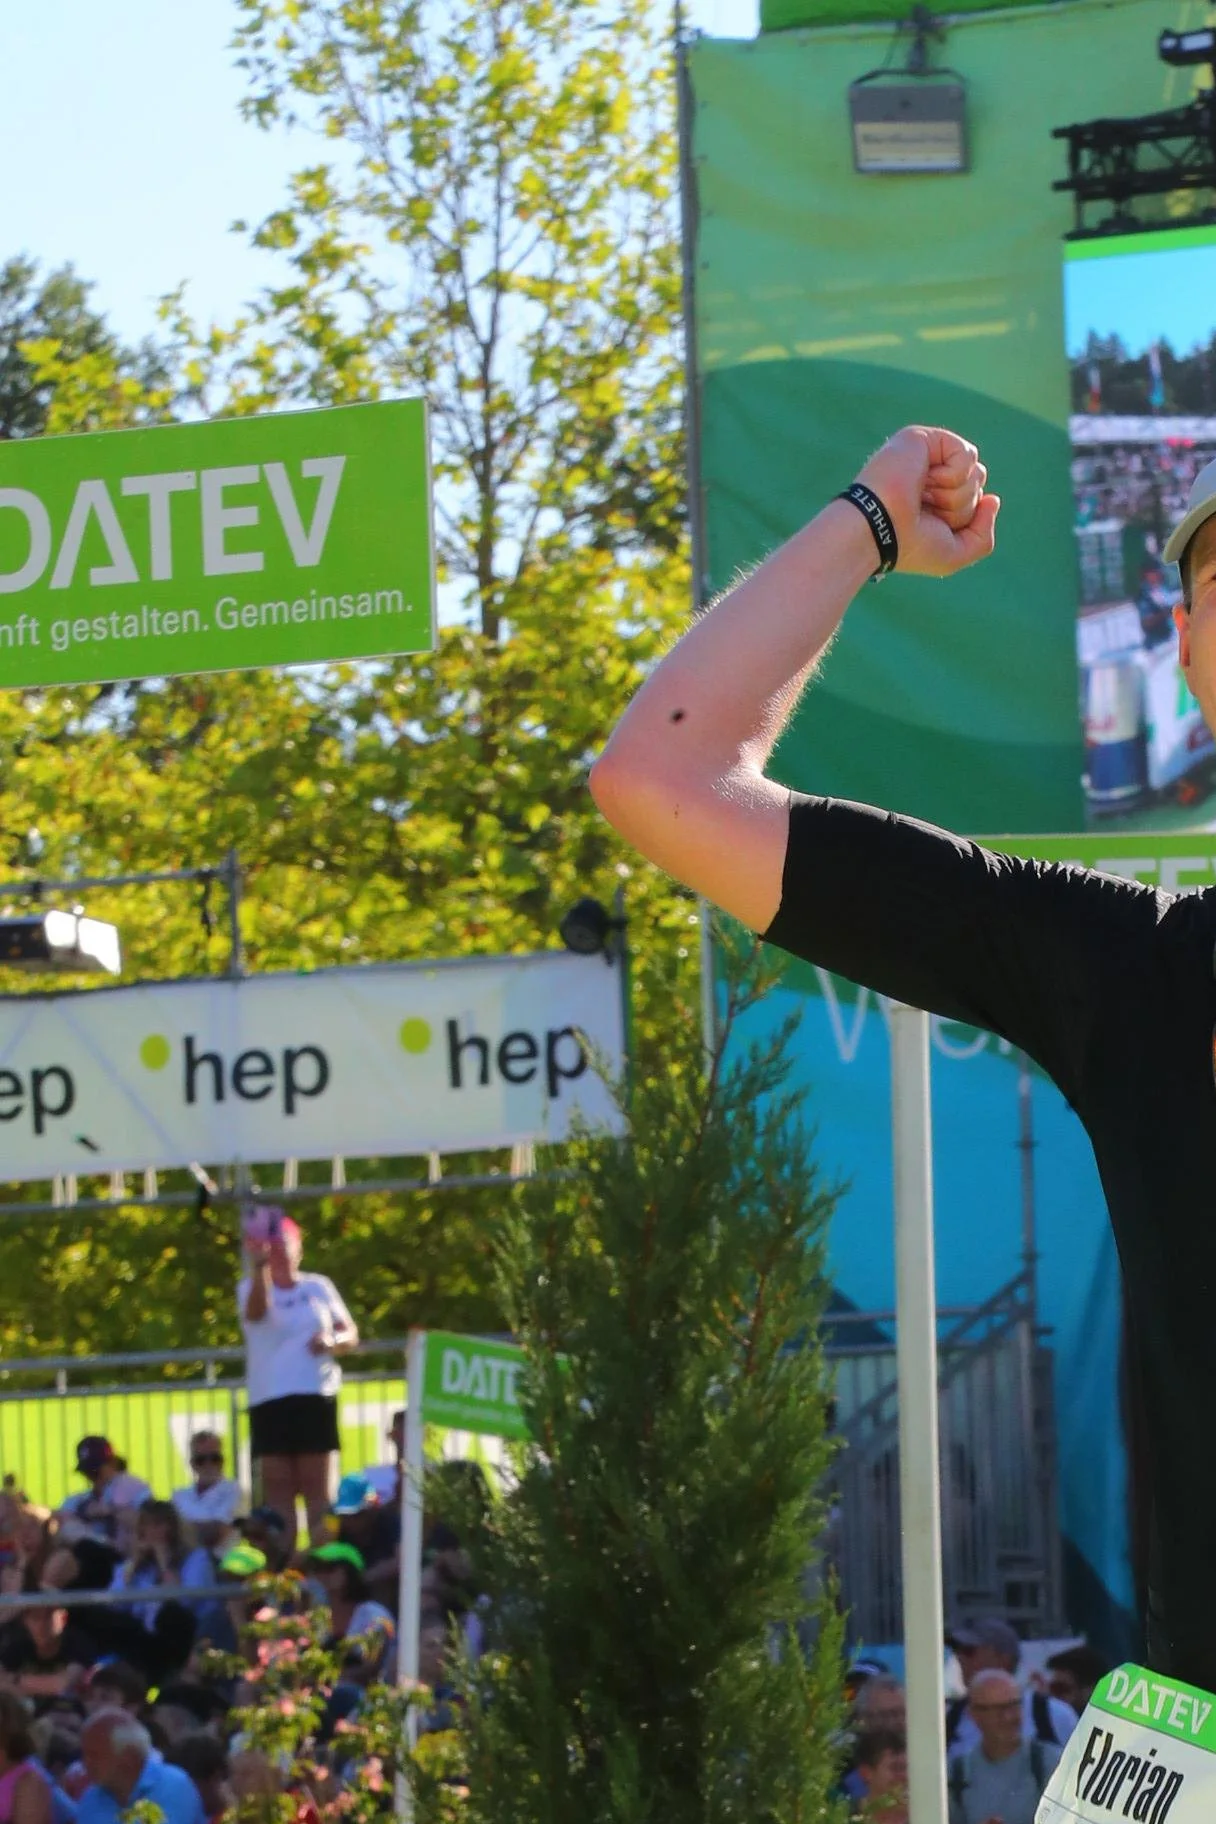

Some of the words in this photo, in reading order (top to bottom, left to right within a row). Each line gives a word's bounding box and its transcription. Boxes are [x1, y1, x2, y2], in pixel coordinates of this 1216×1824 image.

[850, 487, 892, 546] ATHLETE
[51, 604, 209, 651] gestalten.
[215, 588, 413, 630] Gemeinsam.
[182, 1035, 331, 1115] hep
[447, 1018, 591, 1098] hep
[1105, 1670, 1213, 1735] DATEV
